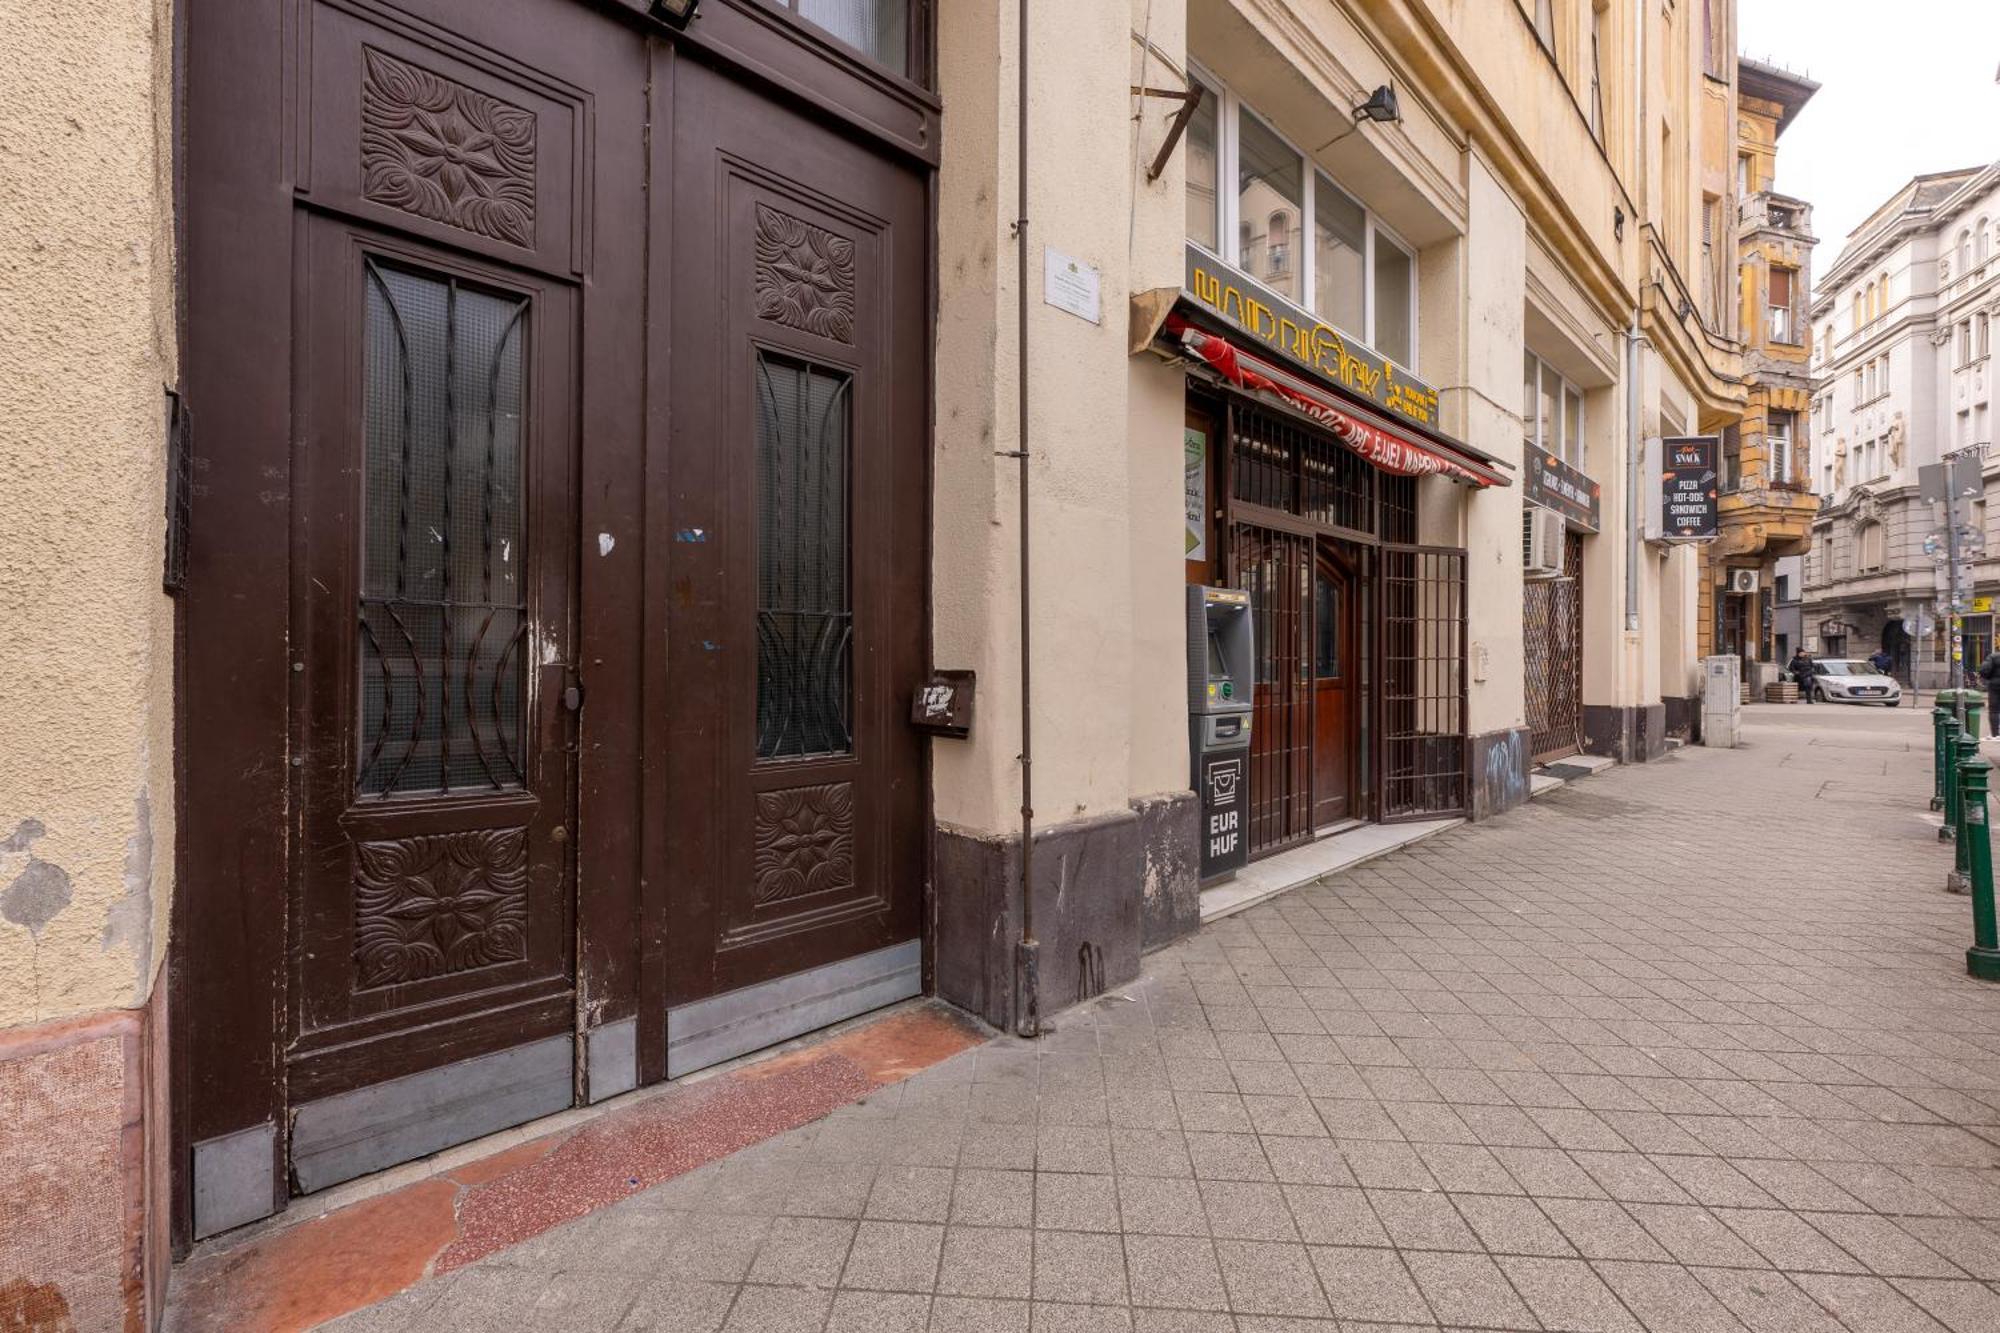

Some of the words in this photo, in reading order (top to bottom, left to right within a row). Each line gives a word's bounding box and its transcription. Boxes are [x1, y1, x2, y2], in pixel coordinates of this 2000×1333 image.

[1347, 423, 1371, 454] ABC
[1370, 431, 1401, 468] ÉJJEL
[1678, 480, 1698, 490] PIZZA
[1672, 492, 1705, 502] HOT-DOG
[1670, 504, 1708, 515] SANDWICH
[1676, 516, 1702, 526] COFFEE
[1210, 810, 1238, 835] EUR
[1210, 832, 1238, 858] HUF
